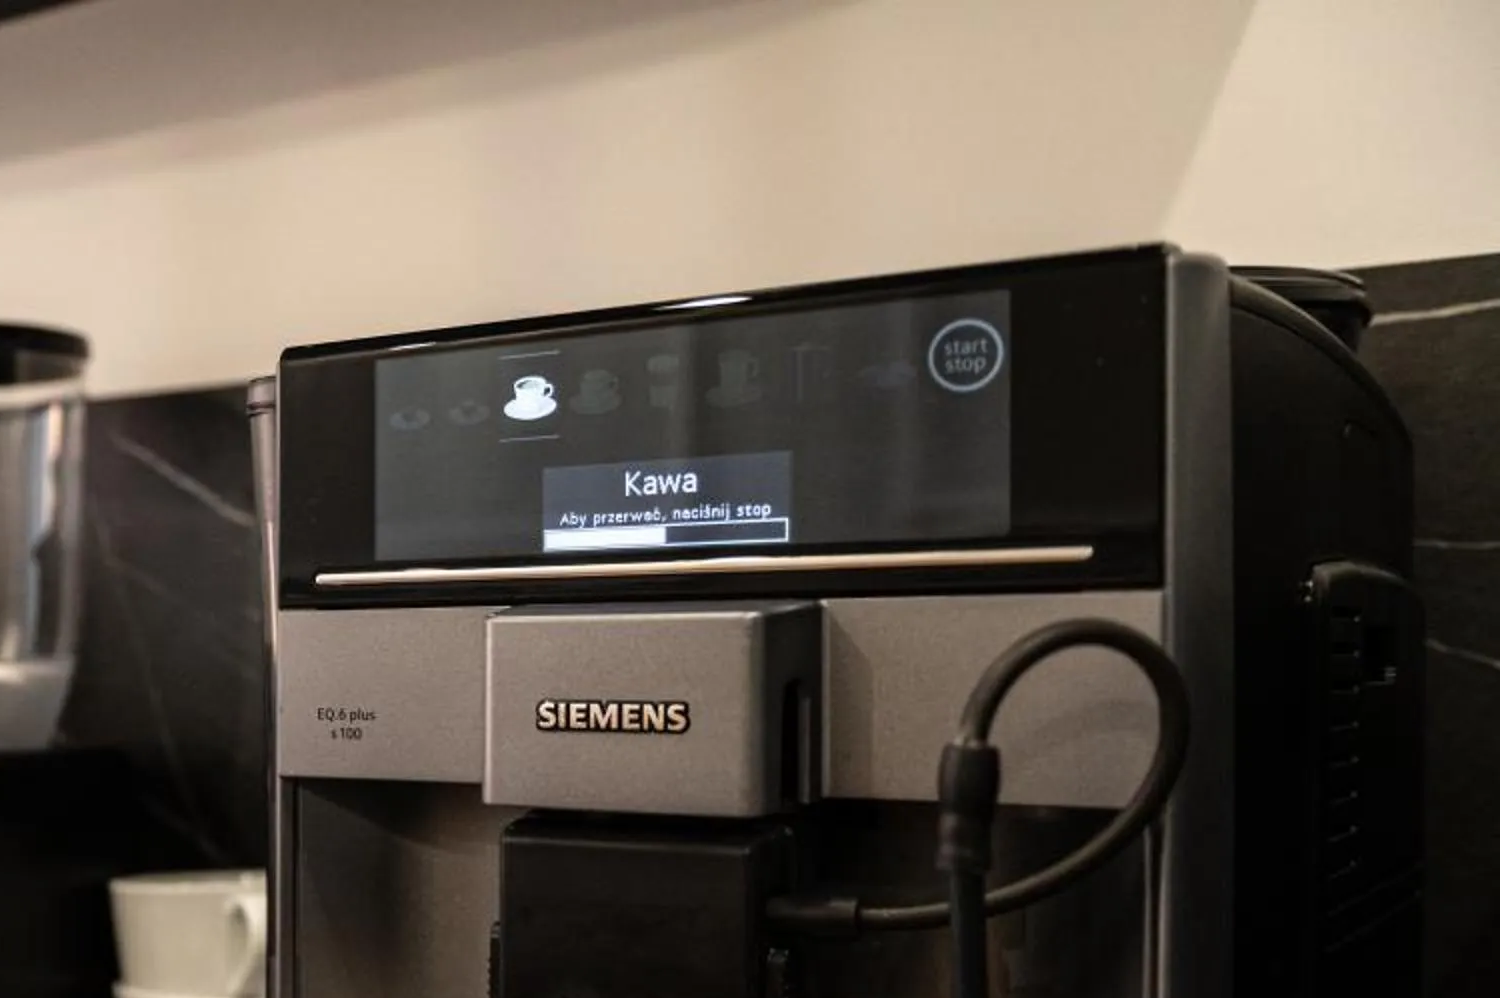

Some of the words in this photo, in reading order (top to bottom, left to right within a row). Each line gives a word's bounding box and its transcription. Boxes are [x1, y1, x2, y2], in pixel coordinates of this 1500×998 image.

[943, 337, 988, 356] start
[945, 356, 987, 375] stop
[624, 470, 698, 496] Kawa
[559, 512, 587, 528] Aby
[736, 503, 772, 520] stop
[349, 706, 376, 724] plus
[537, 699, 690, 734] SIEMENS
[340, 727, 363, 740] 100
